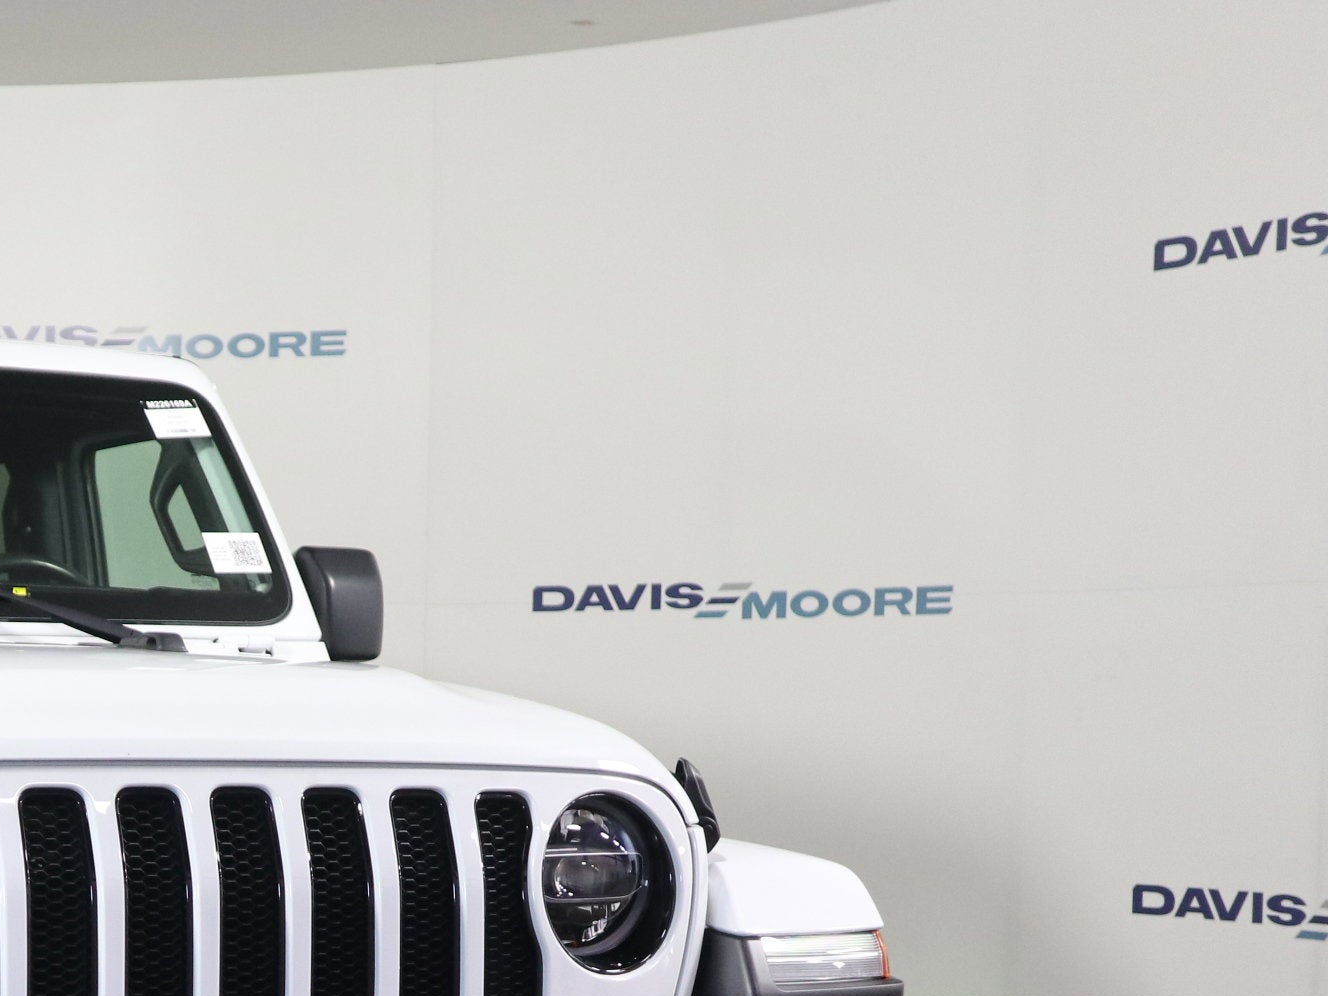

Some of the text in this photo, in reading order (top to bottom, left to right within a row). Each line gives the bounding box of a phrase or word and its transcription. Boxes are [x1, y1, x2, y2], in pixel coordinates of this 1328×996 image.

[1153, 211, 1328, 271] DAVIS
[137, 329, 348, 360] MOORE
[532, 583, 954, 619] DAVIS MOORE
[1132, 884, 1307, 926] DAVIS
